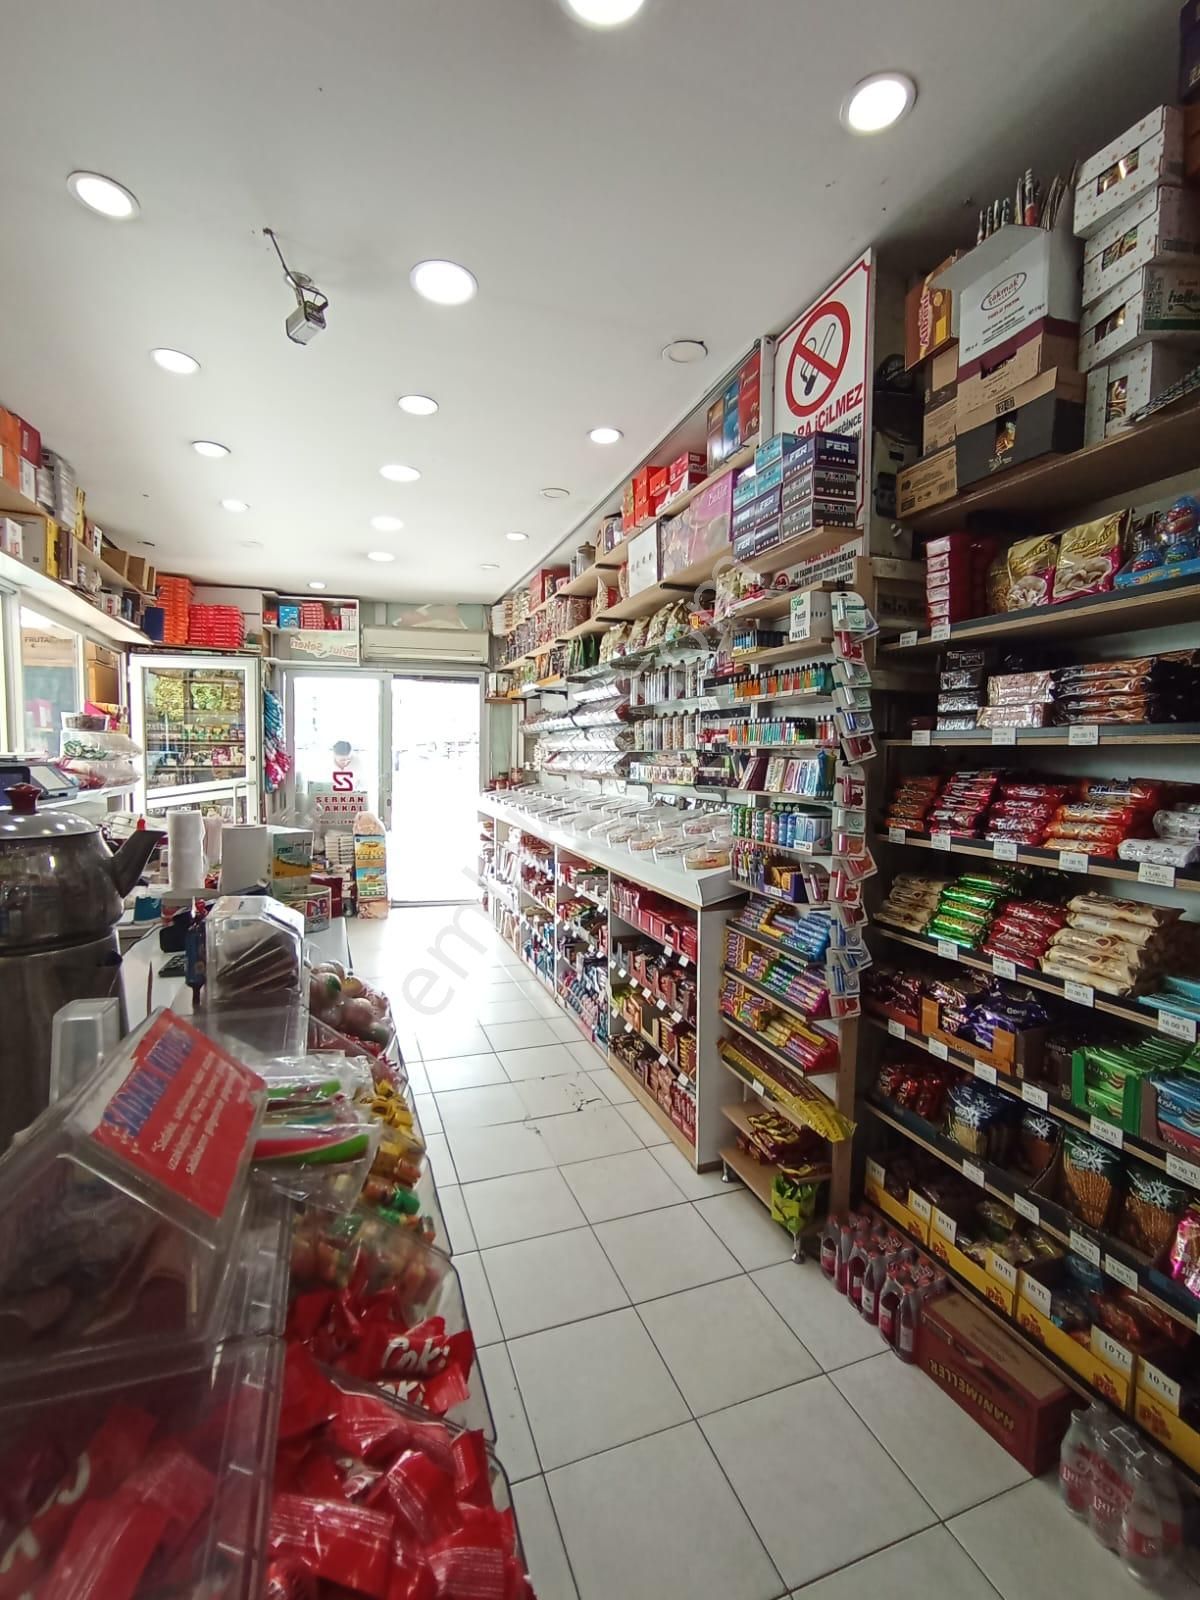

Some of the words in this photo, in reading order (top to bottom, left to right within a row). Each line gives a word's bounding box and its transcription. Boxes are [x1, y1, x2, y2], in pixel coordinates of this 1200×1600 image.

[1036, 1287, 1047, 1301] TL
[1104, 1341, 1114, 1353] 10
[1115, 1349, 1128, 1364] TL
[1148, 1371, 1160, 1385] 10
[1161, 1382, 1175, 1397] TL
